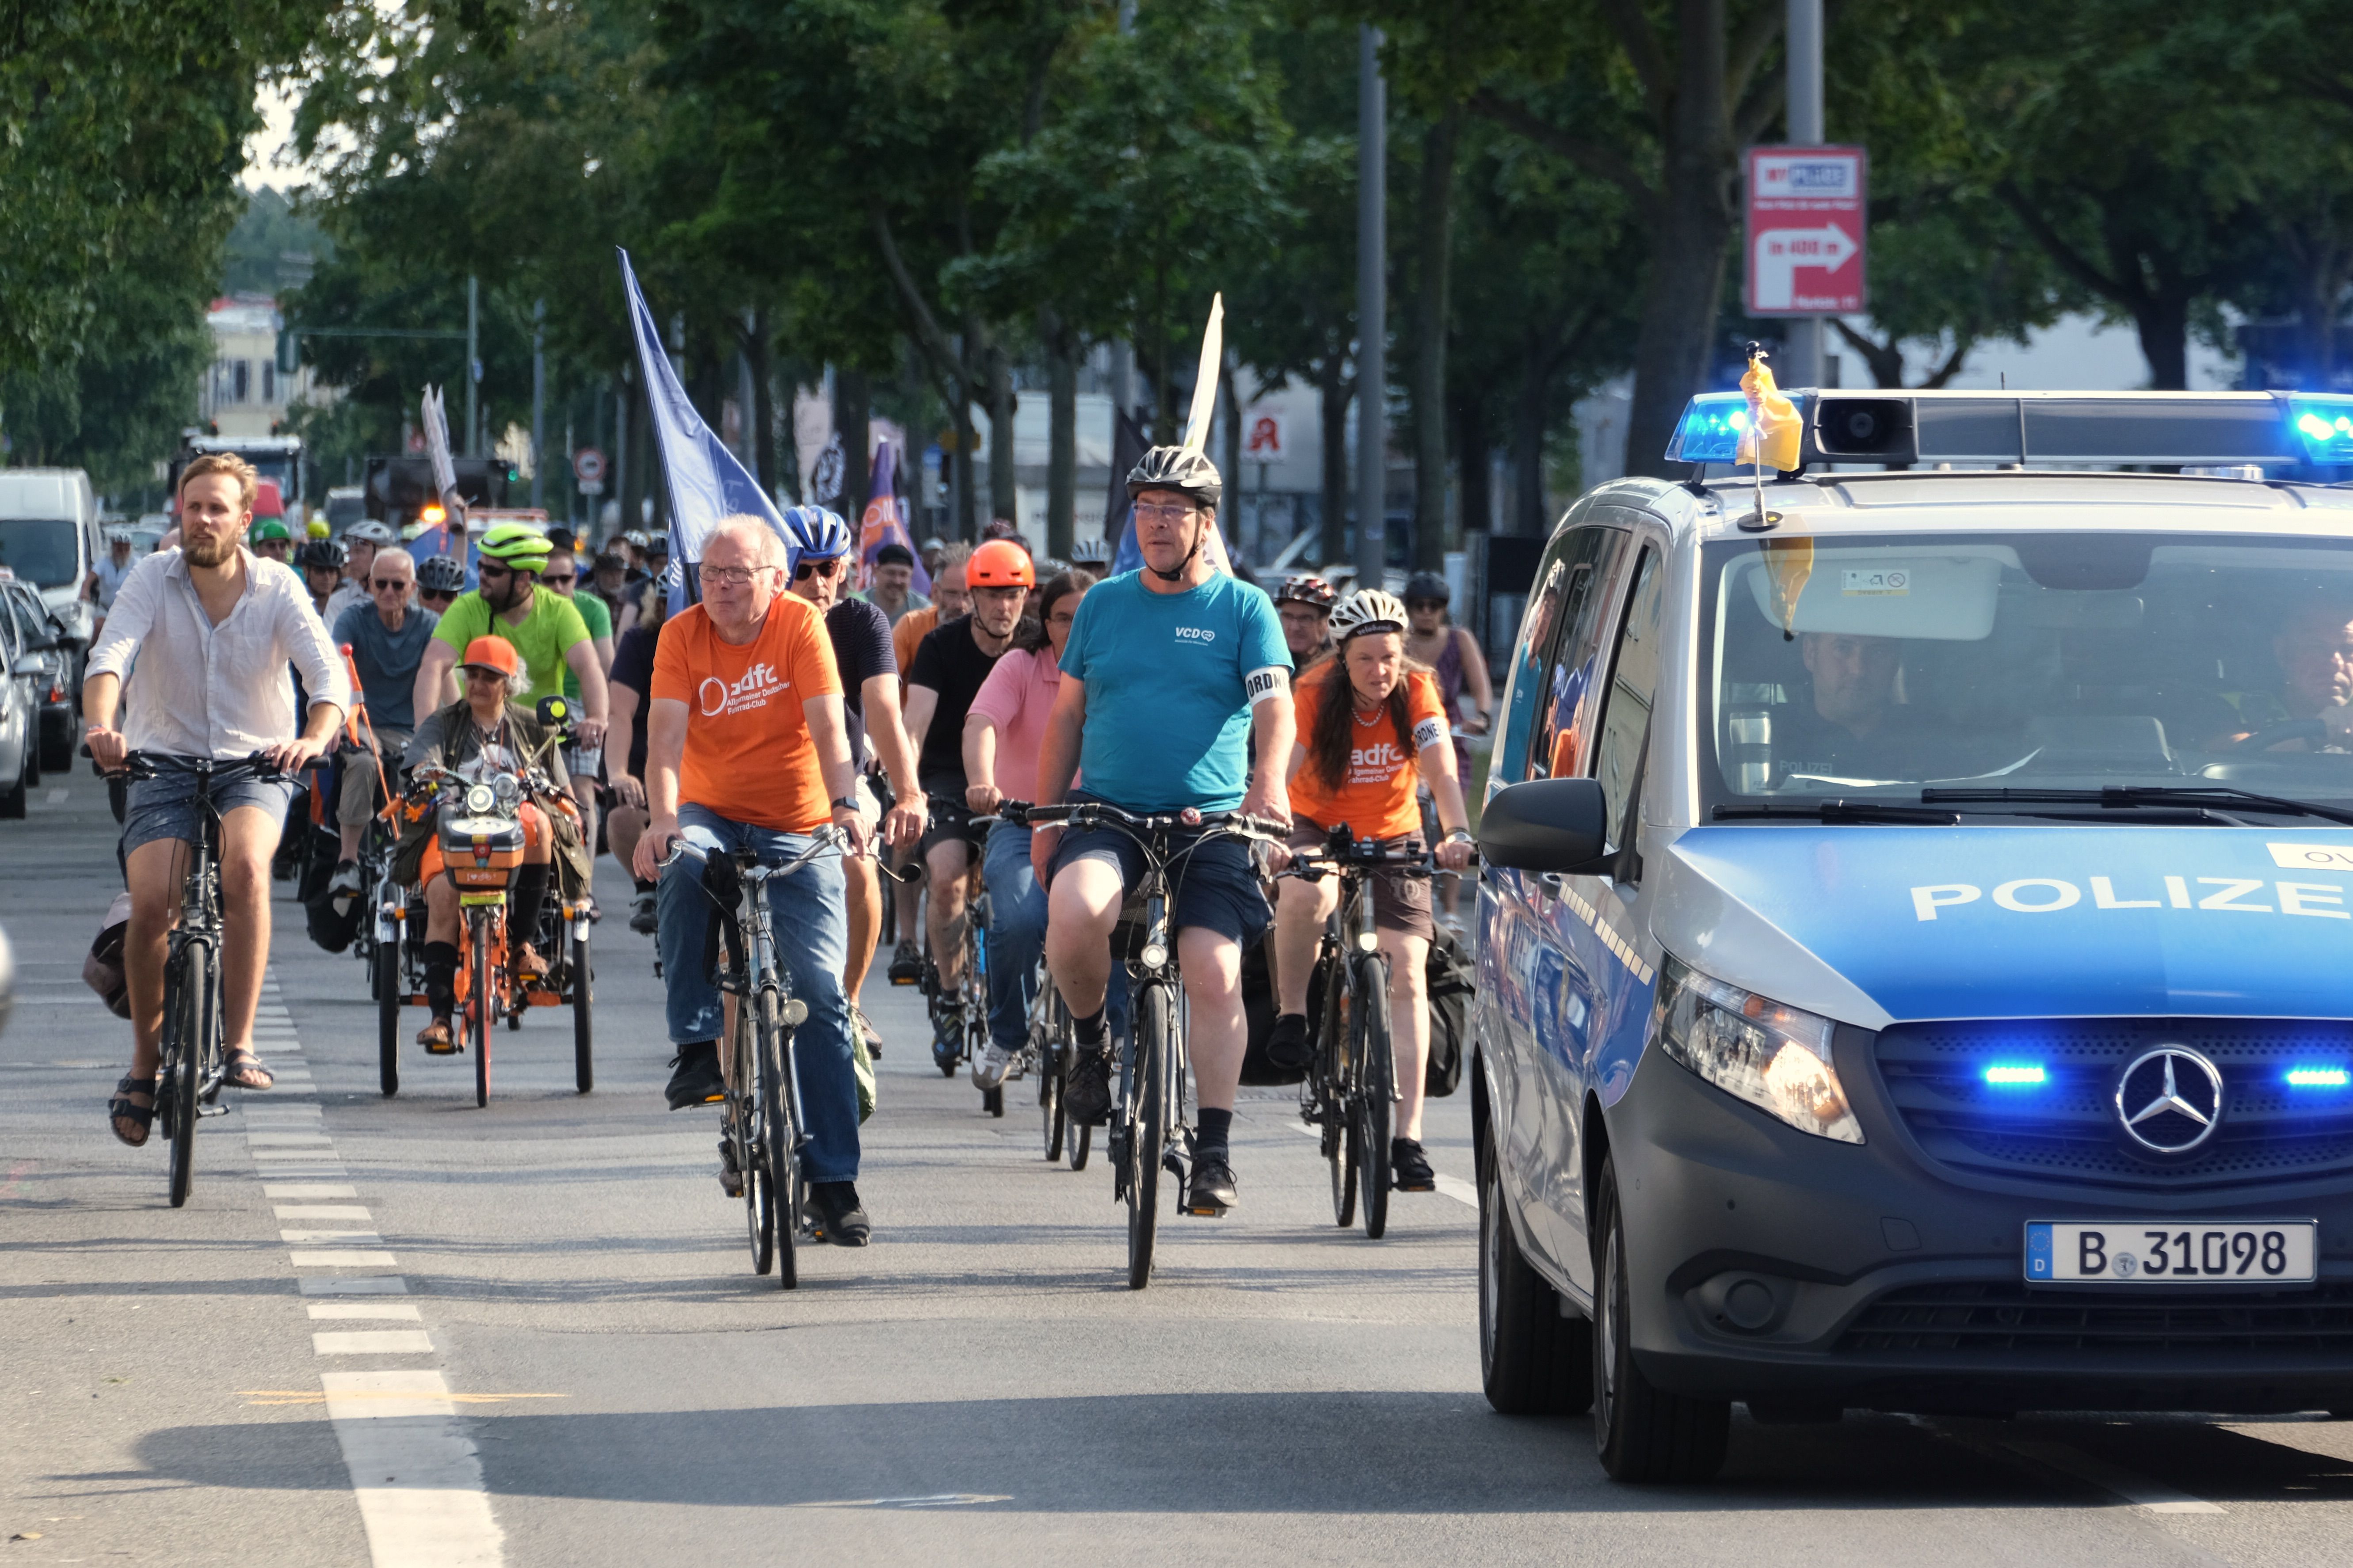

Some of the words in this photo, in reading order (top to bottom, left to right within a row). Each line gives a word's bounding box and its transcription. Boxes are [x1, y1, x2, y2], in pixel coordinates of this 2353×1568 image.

[1175, 627, 1201, 639] VCD
[731, 663, 778, 696] adfc
[1247, 673, 1286, 698] ORDN
[1351, 743, 1403, 765] adfc
[2143, 1231, 2286, 1275] 31098
[2034, 1259, 2045, 1272] D
